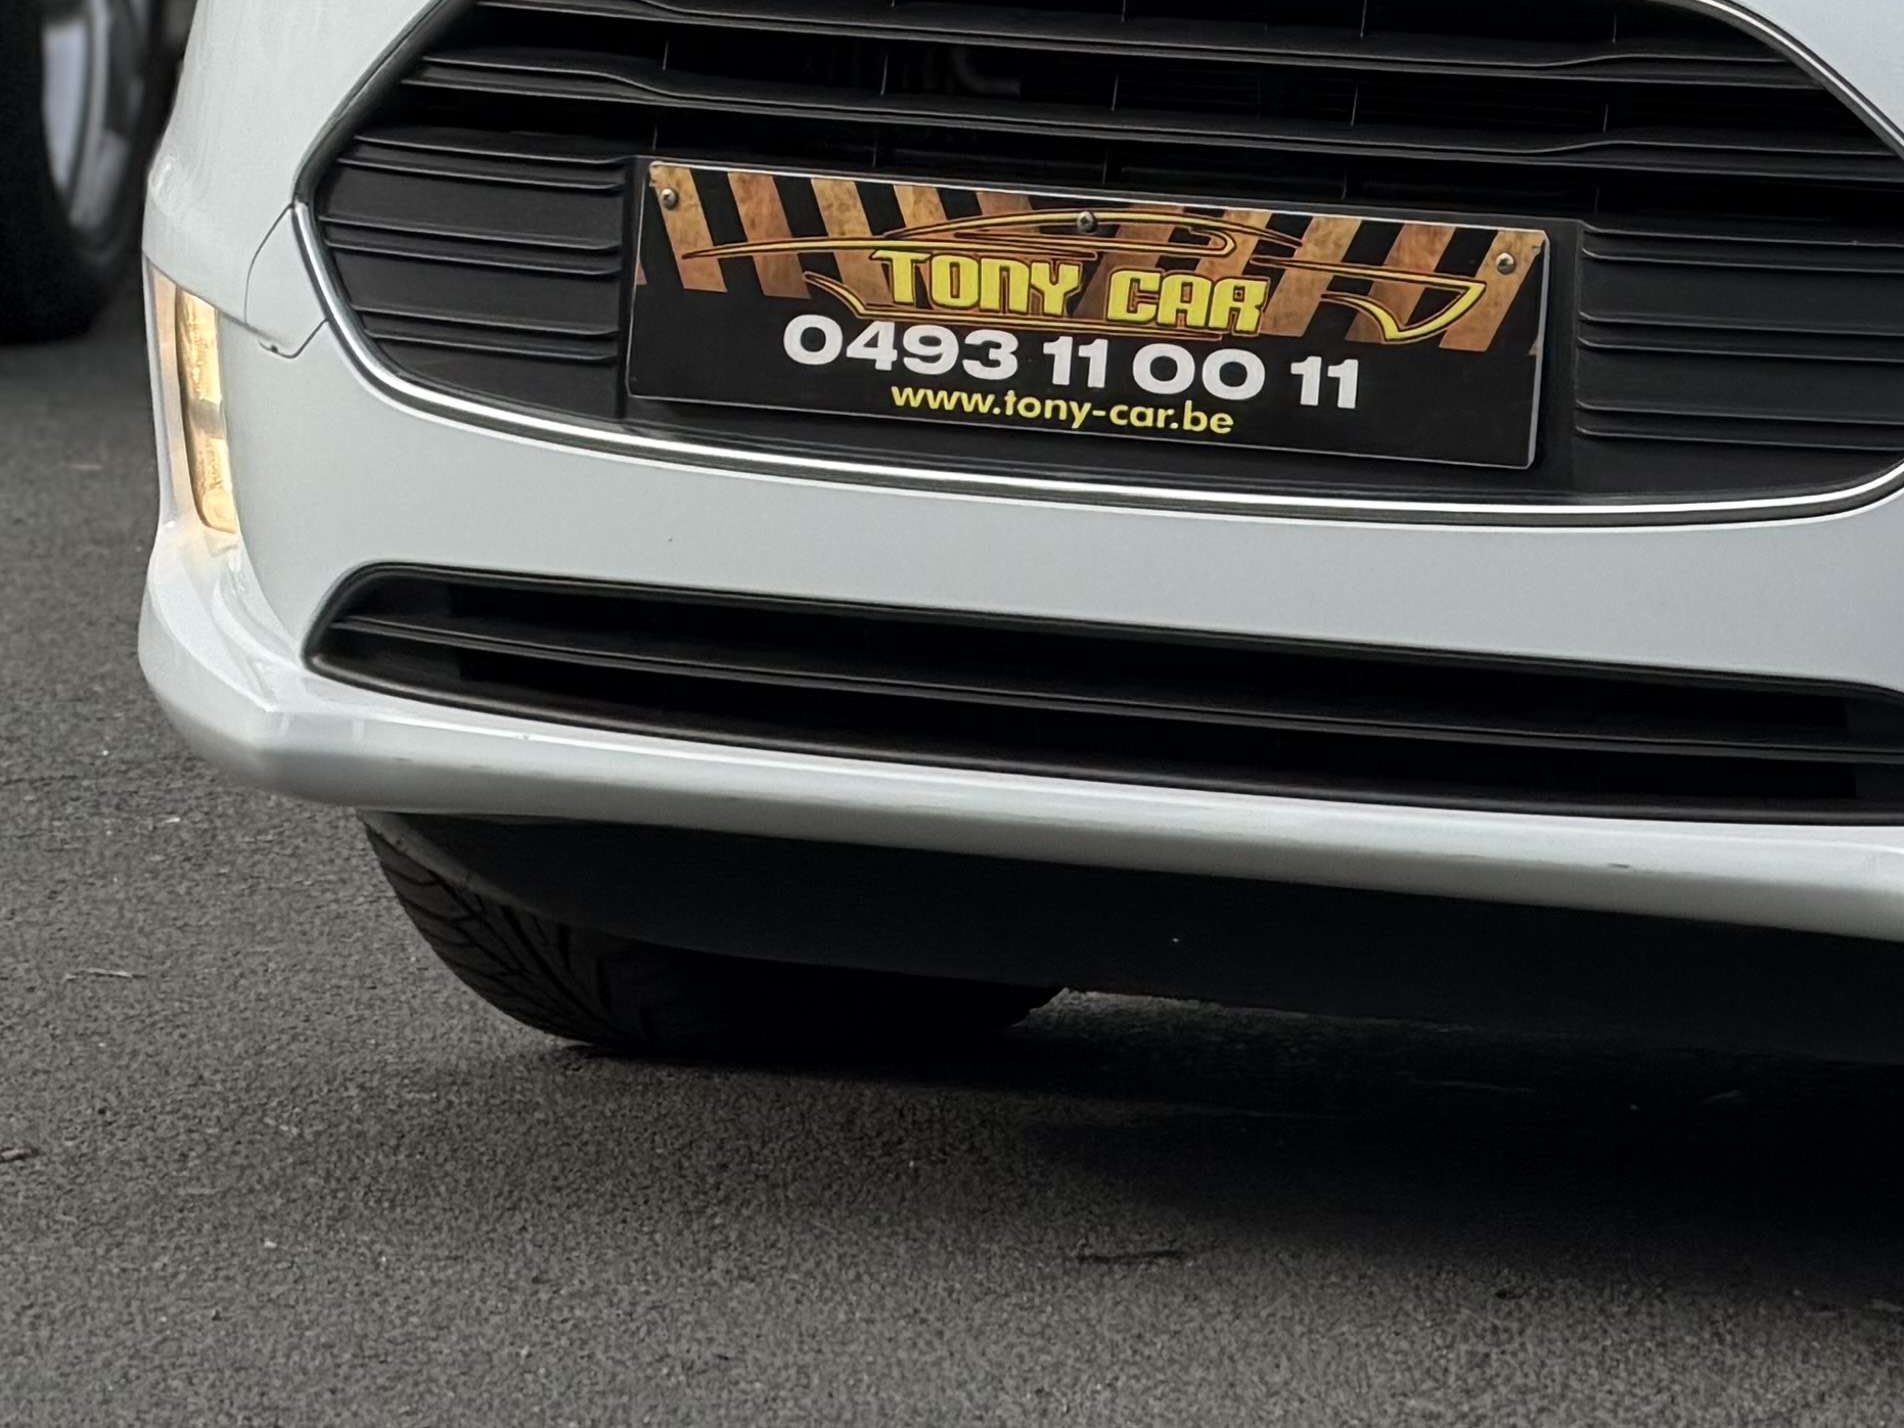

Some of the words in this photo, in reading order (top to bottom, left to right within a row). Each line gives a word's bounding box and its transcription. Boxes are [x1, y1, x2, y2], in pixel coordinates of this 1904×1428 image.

[871, 251, 1081, 317] TONY
[1106, 269, 1268, 331] CAR
[782, 315, 1017, 380] 0493
[1043, 338, 1108, 389] 11
[1132, 344, 1266, 401] 00
[1290, 355, 1360, 408] 11
[890, 384, 1233, 434] www.tony-car.be
